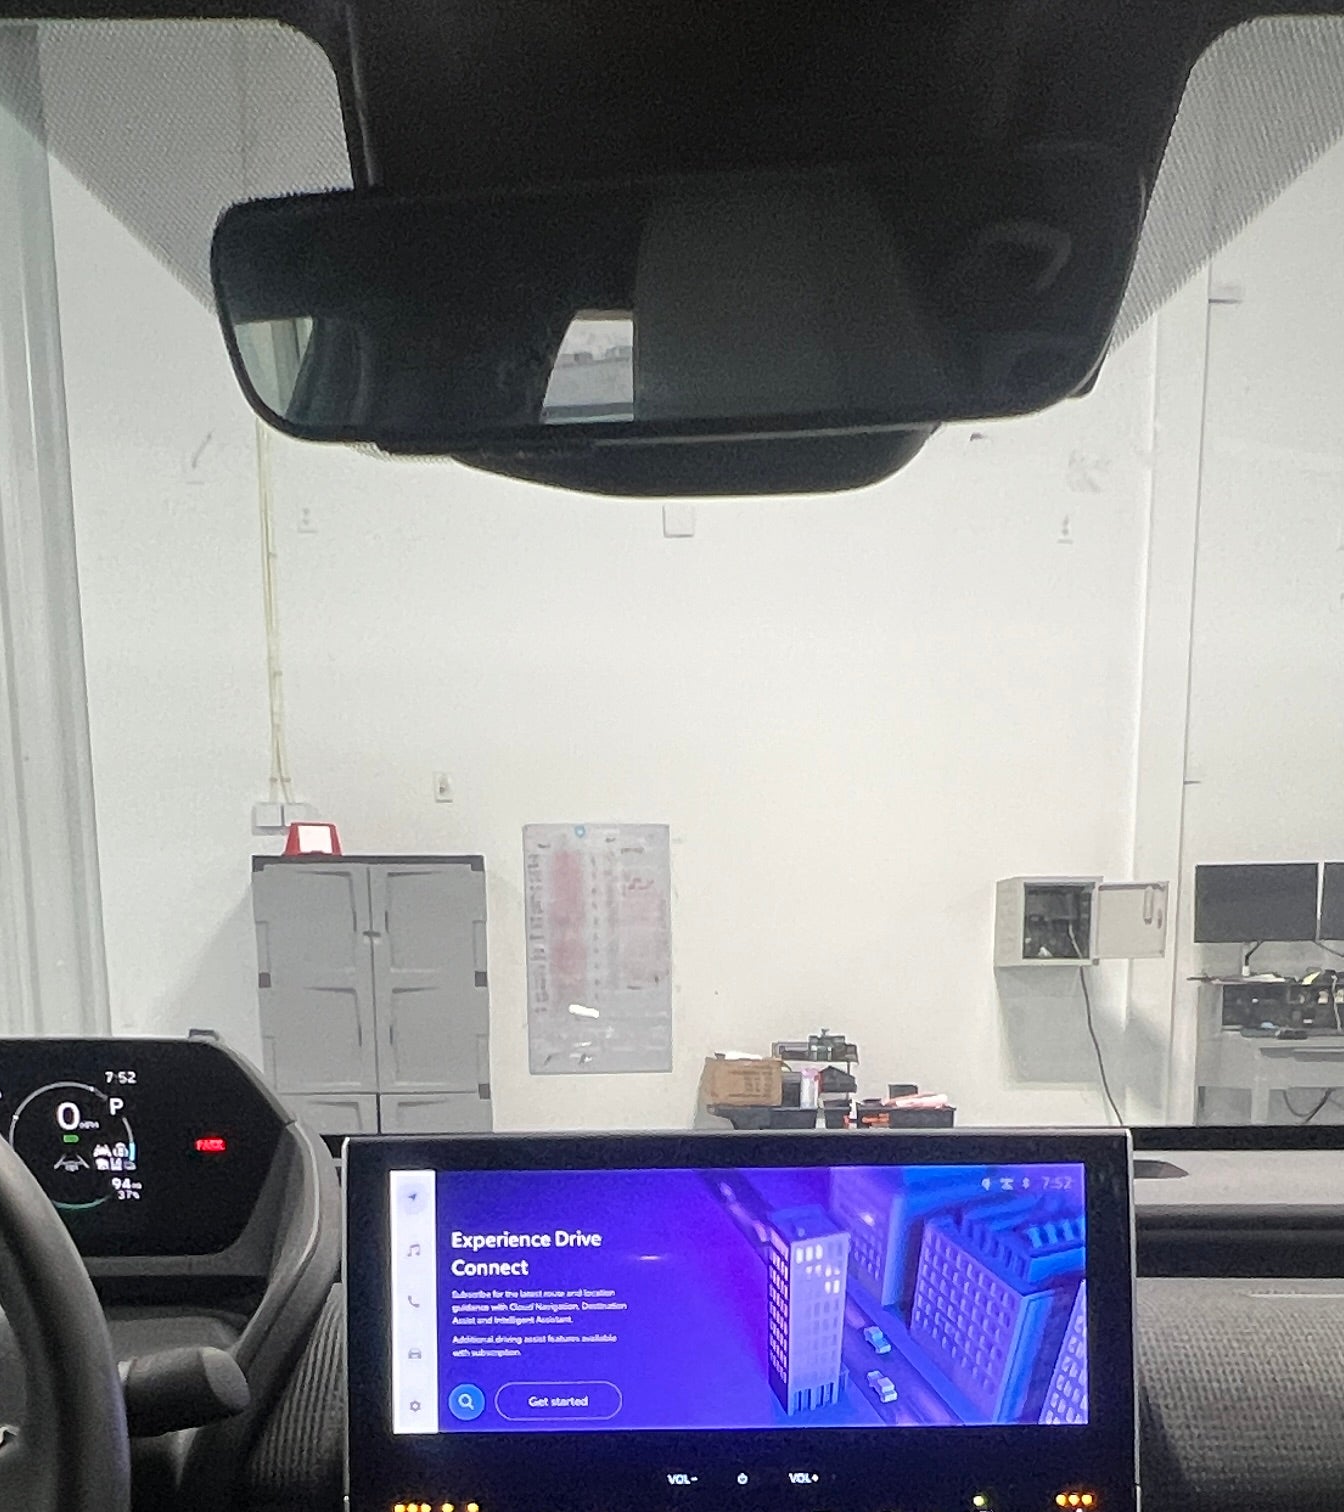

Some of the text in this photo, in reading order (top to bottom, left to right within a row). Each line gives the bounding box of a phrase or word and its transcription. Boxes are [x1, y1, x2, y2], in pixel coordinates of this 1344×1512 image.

[109, 1097, 124, 1116] P
[57, 1102, 80, 1131] 0
[111, 1178, 132, 1190] 94
[451, 1230, 602, 1251] Experience Drive
[451, 1259, 529, 1276] Connect
[451, 1289, 492, 1299] Subscribe
[492, 1289, 505, 1298] for
[566, 1288, 582, 1298] and
[583, 1289, 616, 1298] location
[490, 1302, 509, 1311] with
[509, 1302, 534, 1311] Cloud
[581, 1301, 628, 1311] Destination
[451, 1316, 476, 1325] Assist
[476, 1316, 493, 1325] and
[493, 1315, 535, 1326] Intelligent
[452, 1333, 618, 1345] Additional driving assist features available
[528, 1395, 589, 1407] Get started
